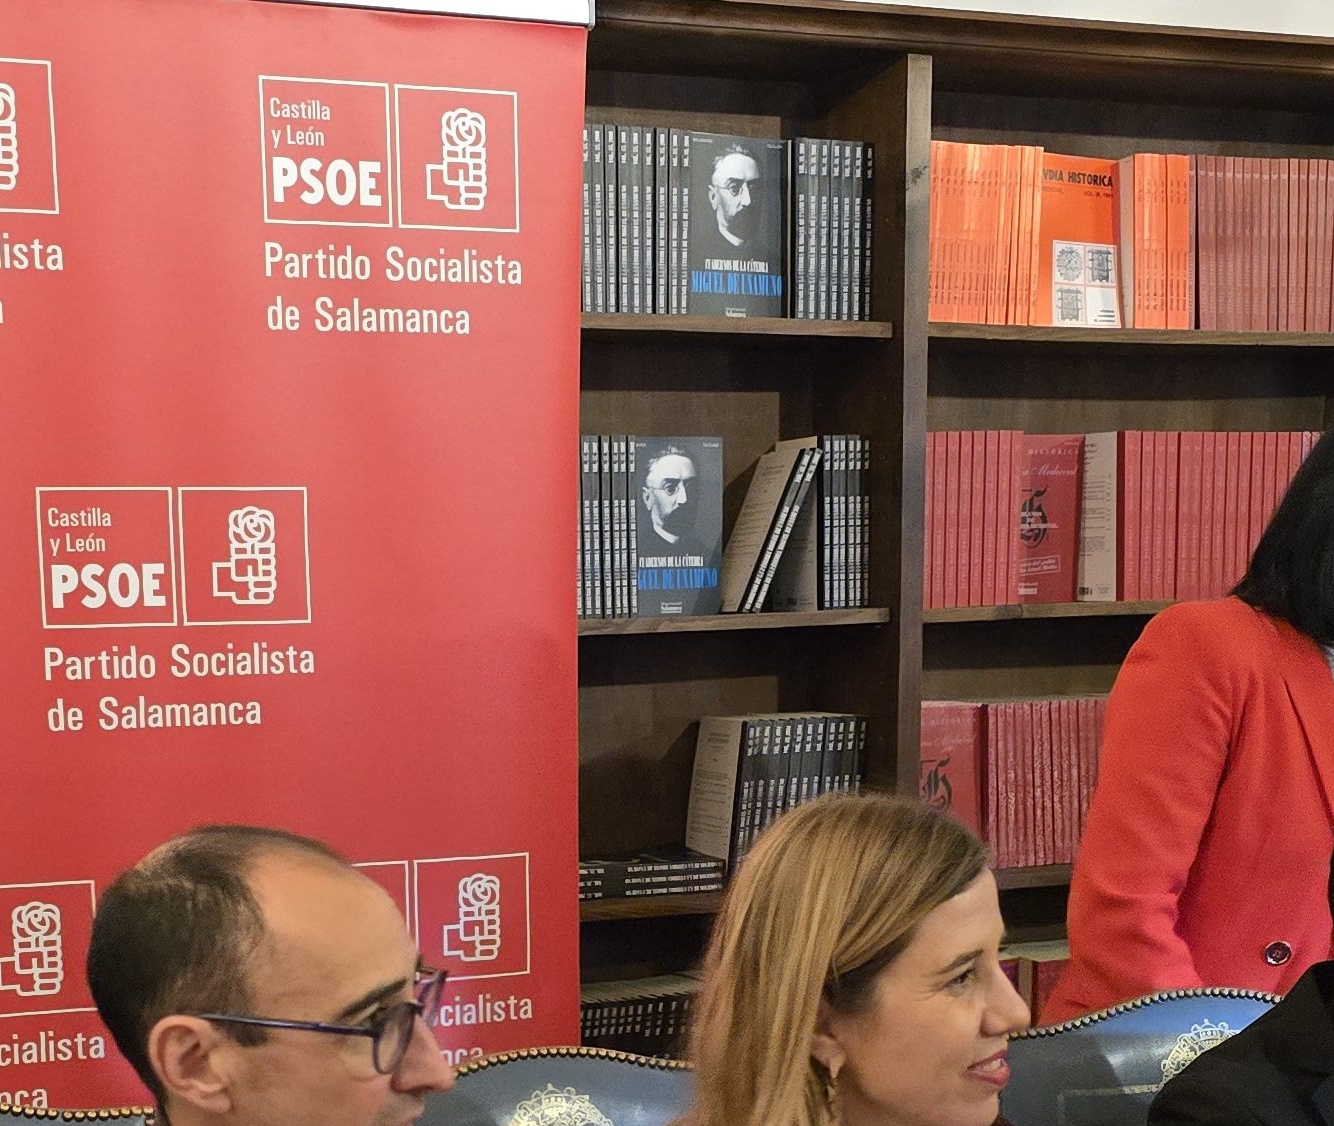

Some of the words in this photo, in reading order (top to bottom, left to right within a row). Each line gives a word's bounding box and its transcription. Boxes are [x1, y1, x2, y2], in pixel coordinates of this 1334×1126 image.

[269, 97, 331, 121] Castilla
[271, 130, 282, 149] y
[287, 125, 325, 147] León
[272, 156, 382, 207] PSOE
[1042, 167, 1064, 183] VDIA
[1067, 171, 1114, 188] HISTORICA
[264, 241, 371, 281] Partido
[385, 246, 522, 285] Socialista
[267, 295, 300, 331] de
[315, 296, 470, 335] Salamanca
[47, 507, 112, 528] Castilla
[49, 537, 60, 557] y
[66, 533, 106, 553] León
[51, 562, 167, 609] PSOE
[43, 645, 156, 681] Partido
[170, 641, 315, 678] Socialista
[47, 698, 84, 732] de
[99, 695, 261, 731] Salamanca
[434, 993, 533, 1028] cialista
